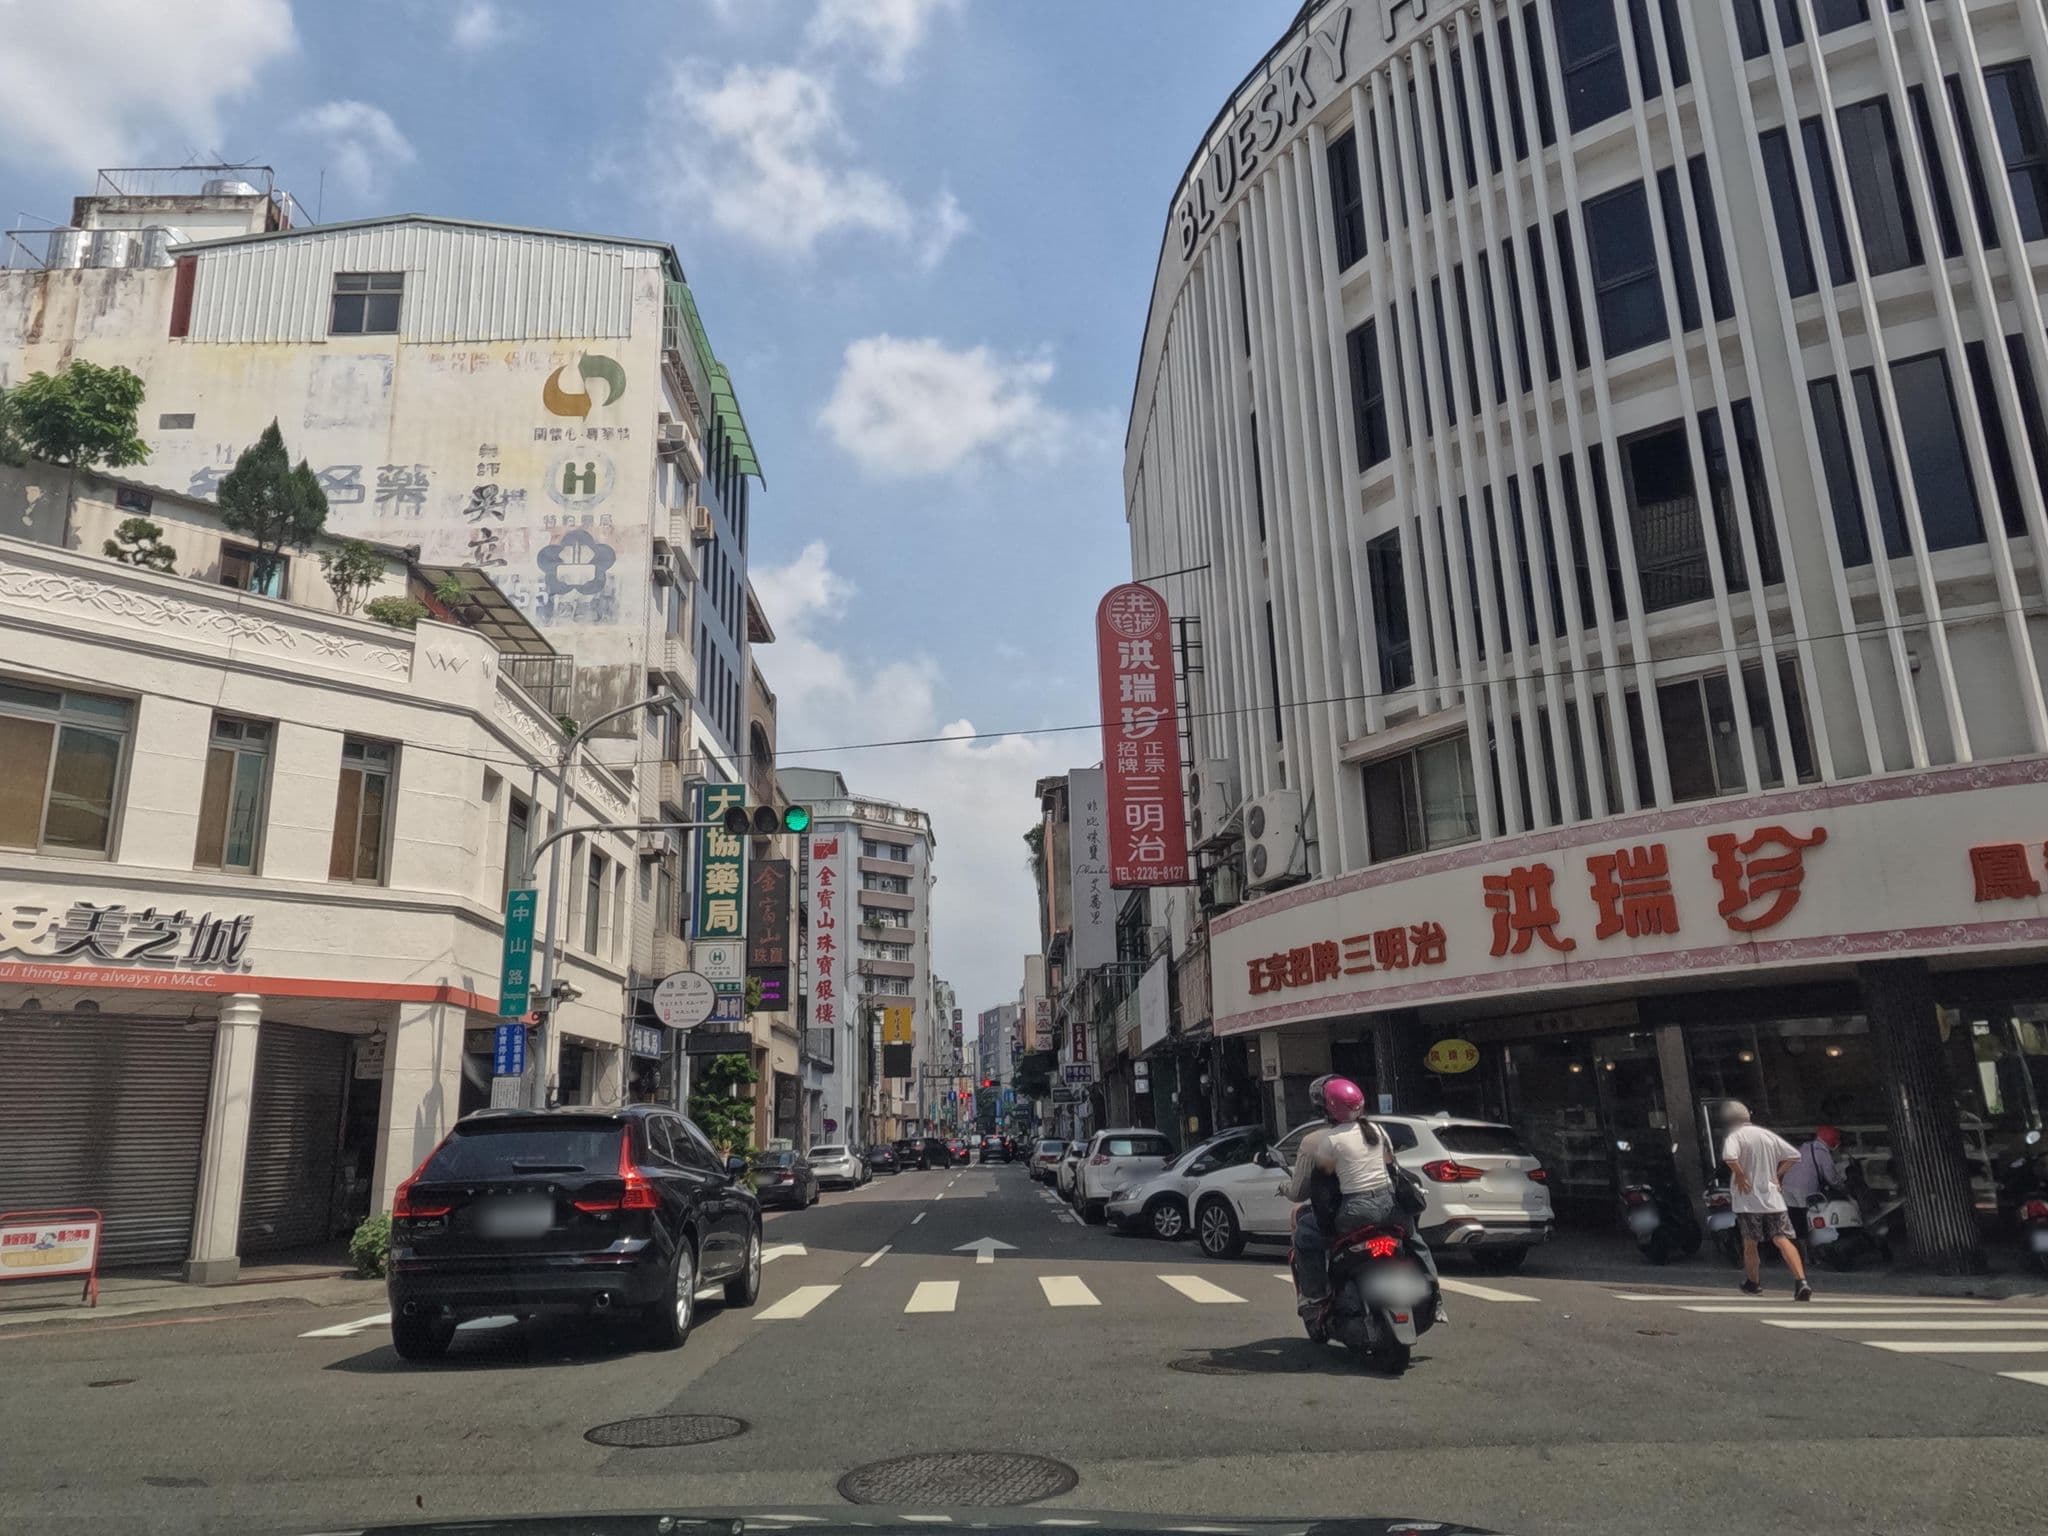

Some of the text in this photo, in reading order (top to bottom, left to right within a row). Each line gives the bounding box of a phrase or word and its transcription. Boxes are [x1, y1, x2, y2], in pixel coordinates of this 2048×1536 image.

[1178, 6, 1353, 262] BLUESKY
[1118, 640, 1169, 739] 洪瑞珍
[704, 788, 742, 933] 大協藥局
[1123, 776, 1167, 862] 三明治
[1482, 825, 1828, 957] 洪瑞珍
[1968, 840, 2048, 902] 鳳
[22, 965, 71, 983] things
[73, 970, 98, 981] are
[101, 970, 150, 987] always
[154, 975, 167, 985] in
[171, 974, 217, 988] MACC.
[507, 905, 530, 986] 中山路
[815, 865, 837, 1025] 金寶山珠寶銀樓
[1246, 920, 1448, 996] 正宗招牌三明治
